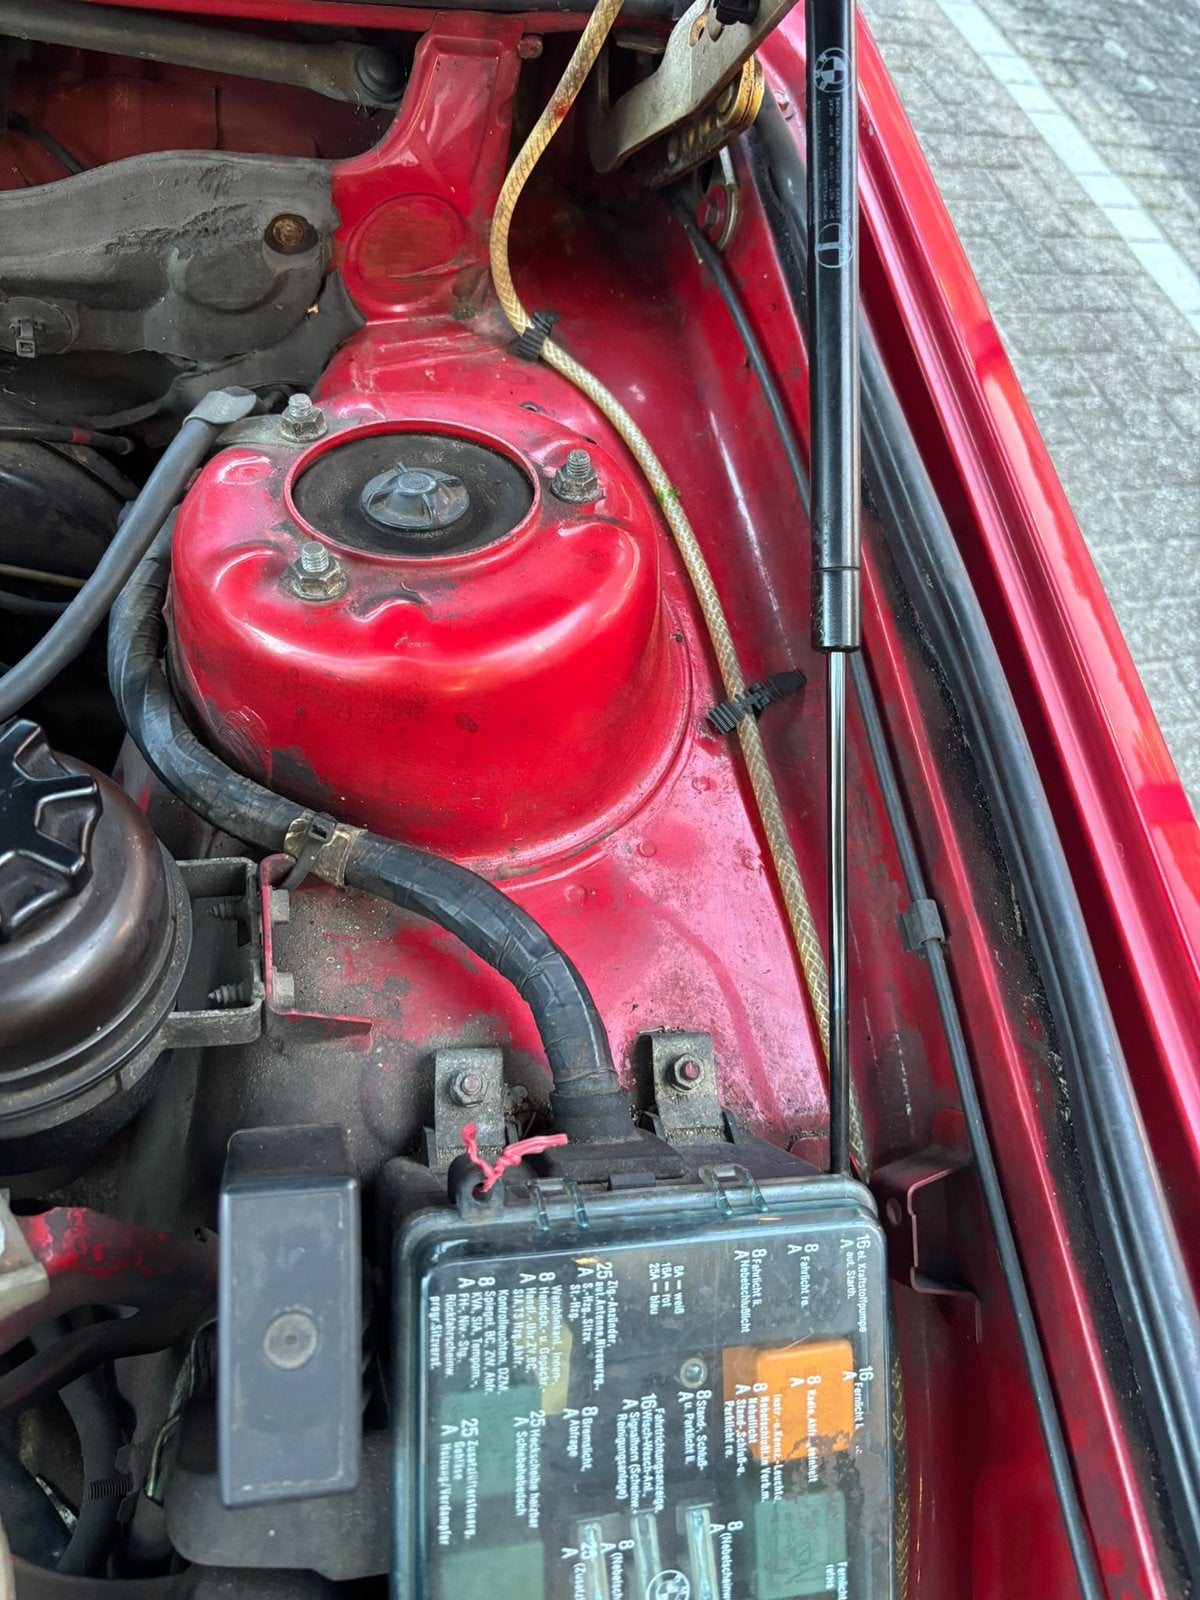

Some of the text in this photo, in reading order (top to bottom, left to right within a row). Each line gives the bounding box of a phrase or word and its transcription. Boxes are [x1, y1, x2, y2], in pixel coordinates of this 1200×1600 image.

[804, 1243, 819, 1253] 8
[840, 1238, 854, 1249] A
[856, 1234, 871, 1249] 16
[734, 1250, 750, 1261] A
[752, 1248, 767, 1258] 8
[787, 1244, 802, 1255] A
[577, 1267, 594, 1278] A
[596, 1261, 613, 1279] 25
[649, 1262, 660, 1280] 25A
[661, 1262, 672, 1279] 16A
[674, 1265, 685, 1278] 8A
[845, 1251, 856, 1300] aut. Starth.
[457, 1277, 476, 1289] A
[478, 1276, 495, 1287] 8
[519, 1273, 536, 1284] A
[539, 1272, 556, 1282] 8
[751, 1258, 762, 1297] Fahrlicht
[800, 1256, 810, 1309] Fahrlicht re.
[740, 1260, 751, 1333] Nebelschlußlicht
[857, 1250, 868, 1333] el. Kraftstoffpumpe
[470, 1291, 482, 1314] KVA,
[649, 1295, 660, 1315] blau
[661, 1293, 672, 1308] rot
[674, 1292, 685, 1315] weiß
[841, 1370, 857, 1382] A
[858, 1365, 873, 1381] 16
[789, 1377, 805, 1388] A
[806, 1375, 821, 1385] 8
[735, 1384, 751, 1395] A
[752, 1382, 768, 1392] 8
[640, 1393, 657, 1409] 16
[677, 1391, 694, 1403] A
[696, 1390, 712, 1400] 8
[854, 1382, 864, 1421] Fernlicht
[622, 1398, 639, 1410] A
[684, 1402, 693, 1411] u.
[562, 1408, 580, 1420] A
[581, 1406, 598, 1417] 8
[513, 1416, 529, 1427] A
[529, 1409, 546, 1428] 25
[747, 1397, 758, 1444] Nebellicht
[440, 1424, 459, 1437] A
[460, 1417, 479, 1438] 25
[684, 1413, 695, 1454] Parklicht
[724, 1401, 735, 1459] Parklicht re.
[566, 1419, 579, 1457] Abfrage
[629, 1411, 641, 1461] Signalhorn
[453, 1441, 465, 1480] Gebläse
[614, 1413, 628, 1500] Reinigungsanlage)
[515, 1430, 528, 1516] Schiebehebedach
[528, 1428, 541, 1528] Heckscheibe heizbar
[436, 1442, 452, 1546] Heizung/Verdampfer
[708, 1524, 726, 1534] A
[727, 1520, 743, 1531] 8
[599, 1542, 617, 1553] A
[617, 1539, 635, 1551] 8
[561, 1547, 579, 1559] A
